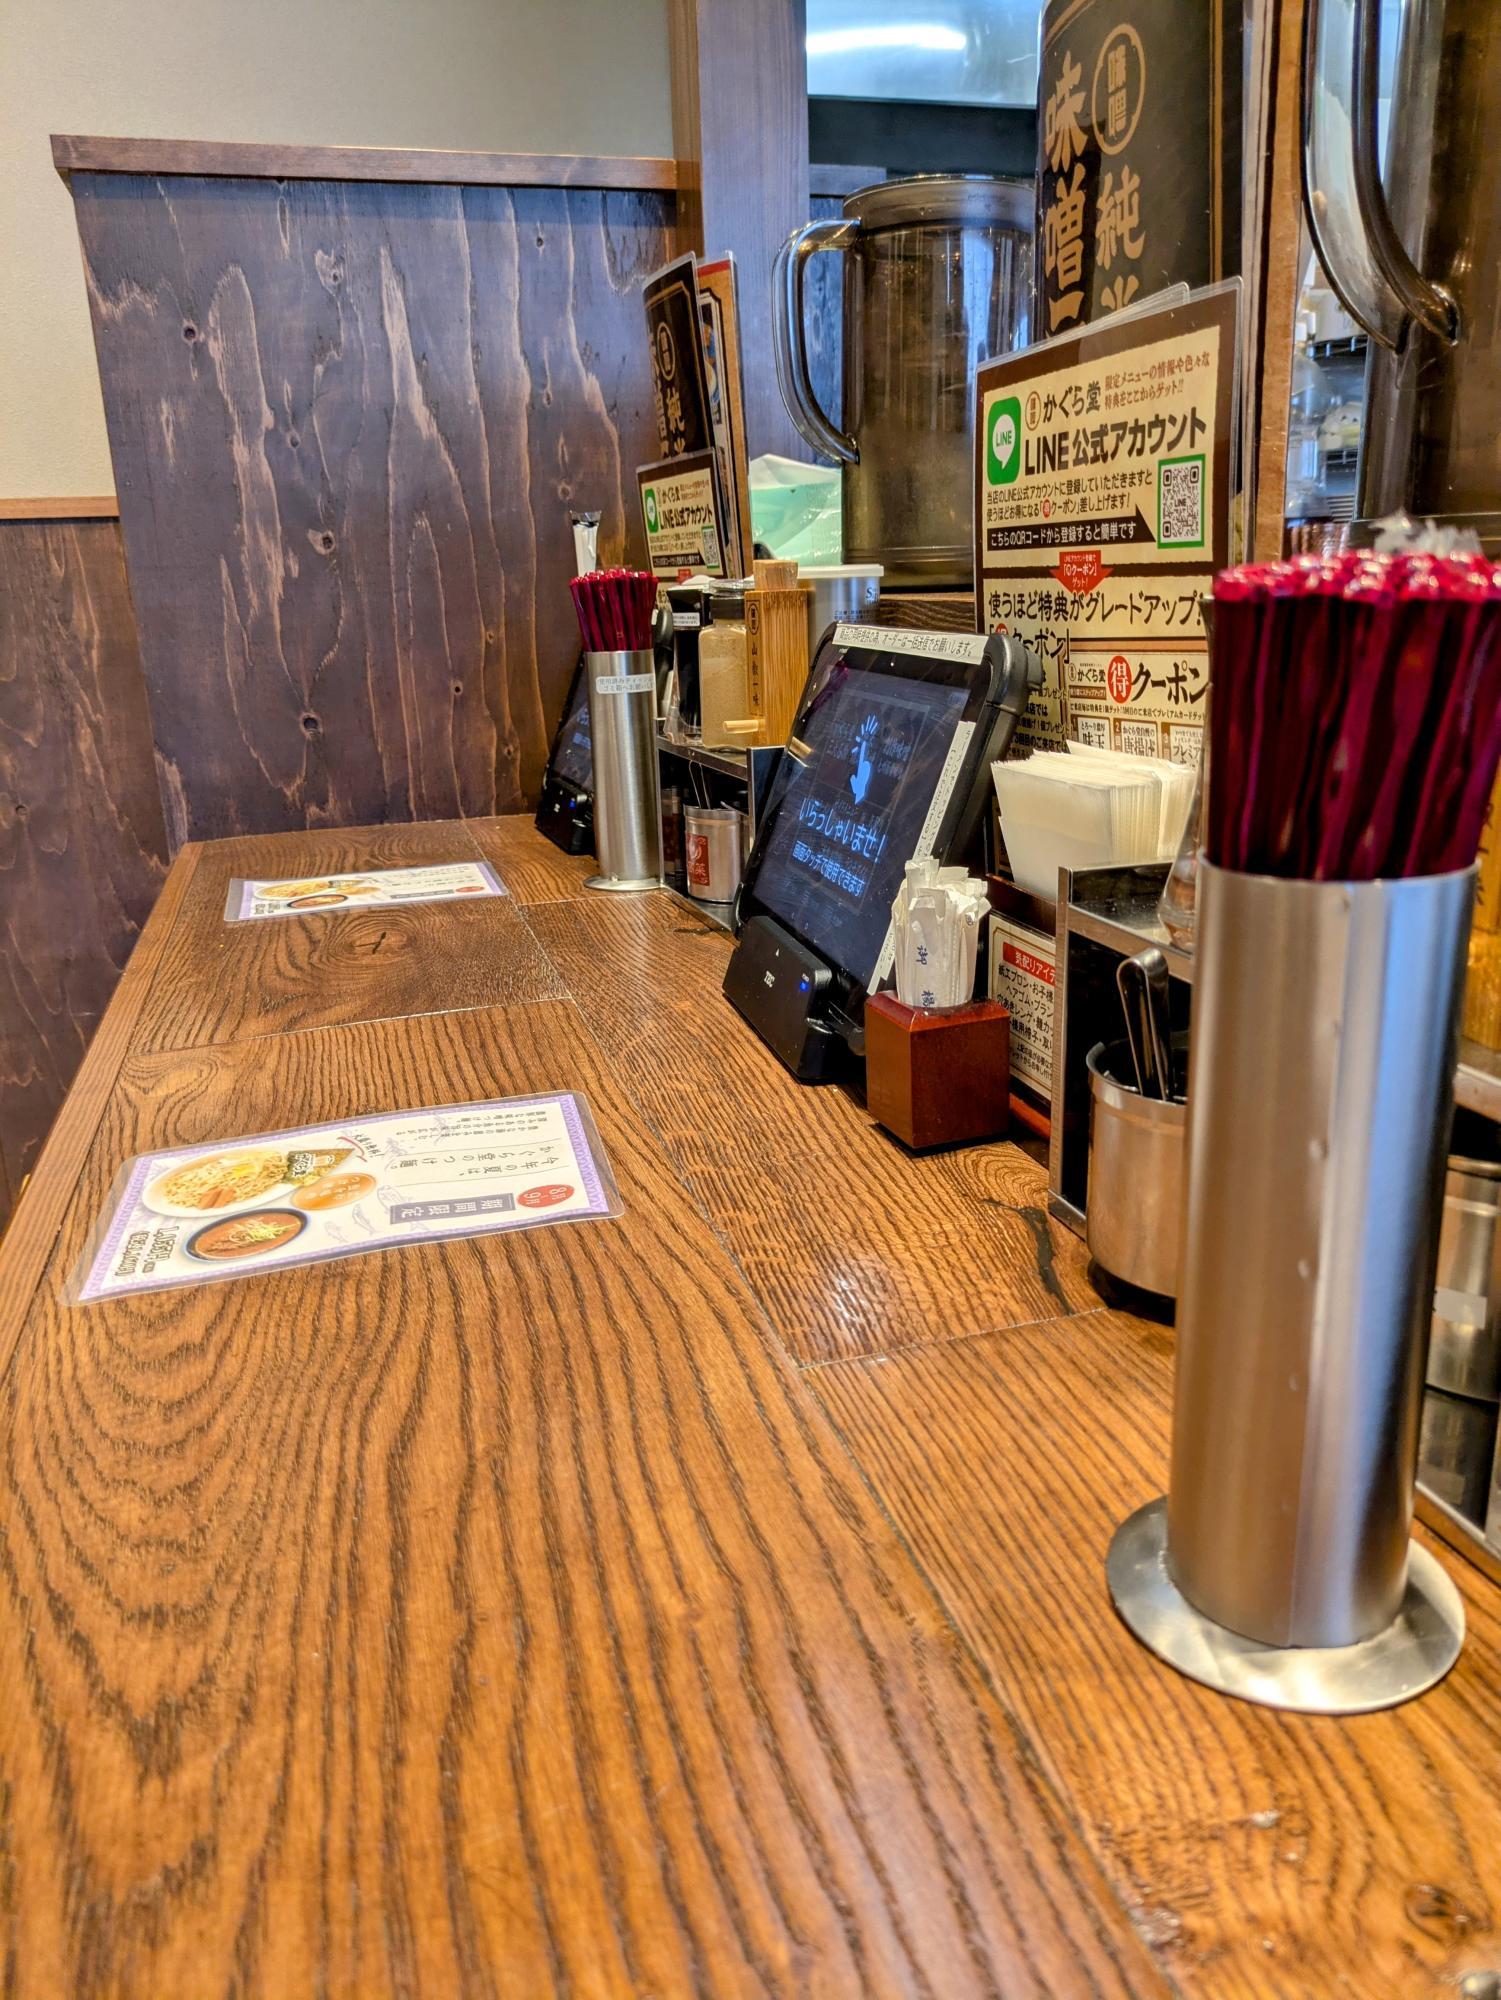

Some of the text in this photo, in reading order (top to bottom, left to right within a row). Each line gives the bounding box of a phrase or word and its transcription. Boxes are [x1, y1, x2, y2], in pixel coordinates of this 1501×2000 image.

[1043, 381, 1101, 423] かぐら堂
[996, 430, 1012, 448] LINE
[991, 521, 1136, 547] こちらのQRコードから登録すると簡単です
[800, 799, 887, 863] いらっしゃいませ!
[792, 841, 865, 897] 画面タッチで使用できます
[401, 1199, 503, 1218] 期間限定
